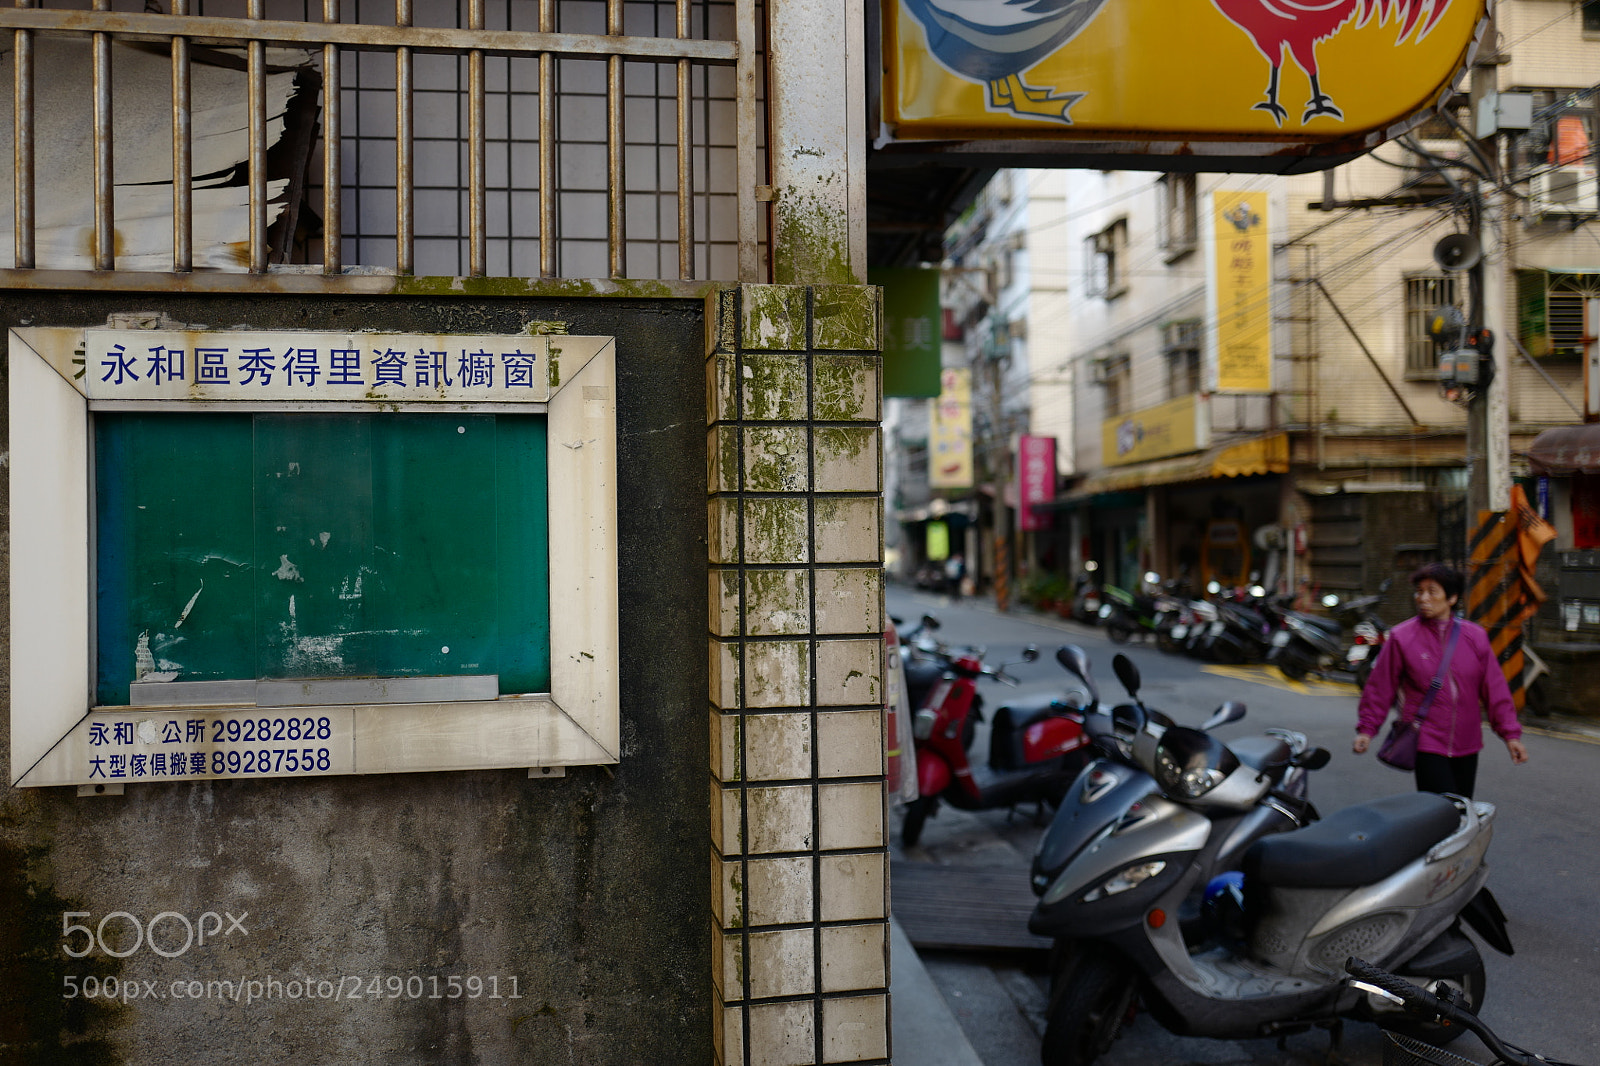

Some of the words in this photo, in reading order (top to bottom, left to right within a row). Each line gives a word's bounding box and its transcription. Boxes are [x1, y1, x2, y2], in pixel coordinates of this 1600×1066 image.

[100, 343, 537, 389] 永和區秀得里資訊櫥窗
[89, 719, 205, 746] 永和公所
[212, 717, 331, 743] 29282828
[89, 752, 206, 779] 大型傢俱搬棄
[211, 748, 331, 775] 89287558
